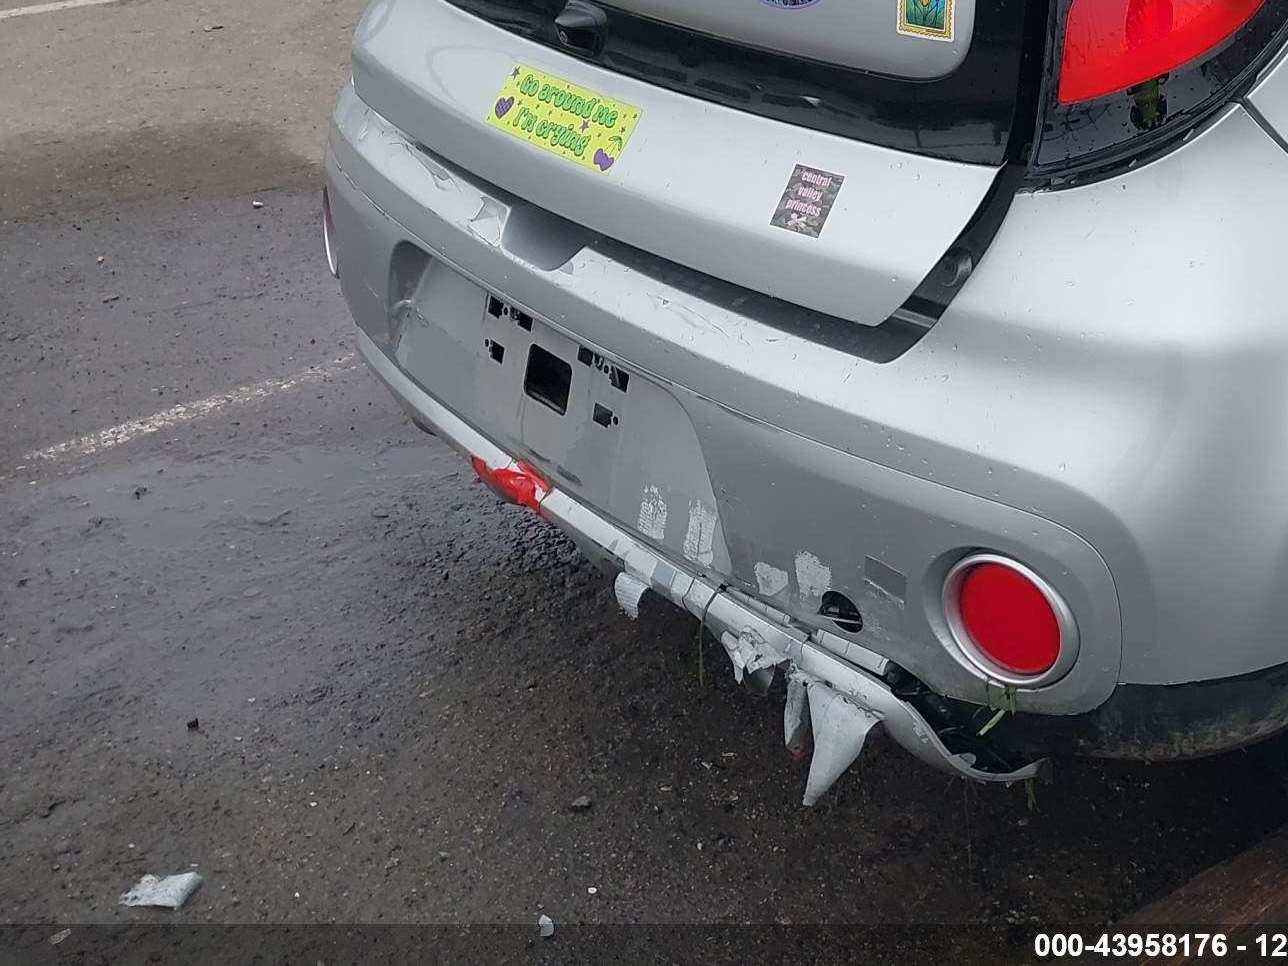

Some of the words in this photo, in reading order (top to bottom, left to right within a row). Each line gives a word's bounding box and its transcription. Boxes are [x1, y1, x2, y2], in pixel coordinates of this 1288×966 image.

[519, 74, 540, 97] Go
[538, 83, 598, 119] around
[591, 103, 619, 129] me
[512, 106, 538, 132] I'm
[535, 119, 592, 157] crying
[801, 170, 833, 187] central
[797, 186, 824, 202] valley
[785, 199, 822, 217] princess
